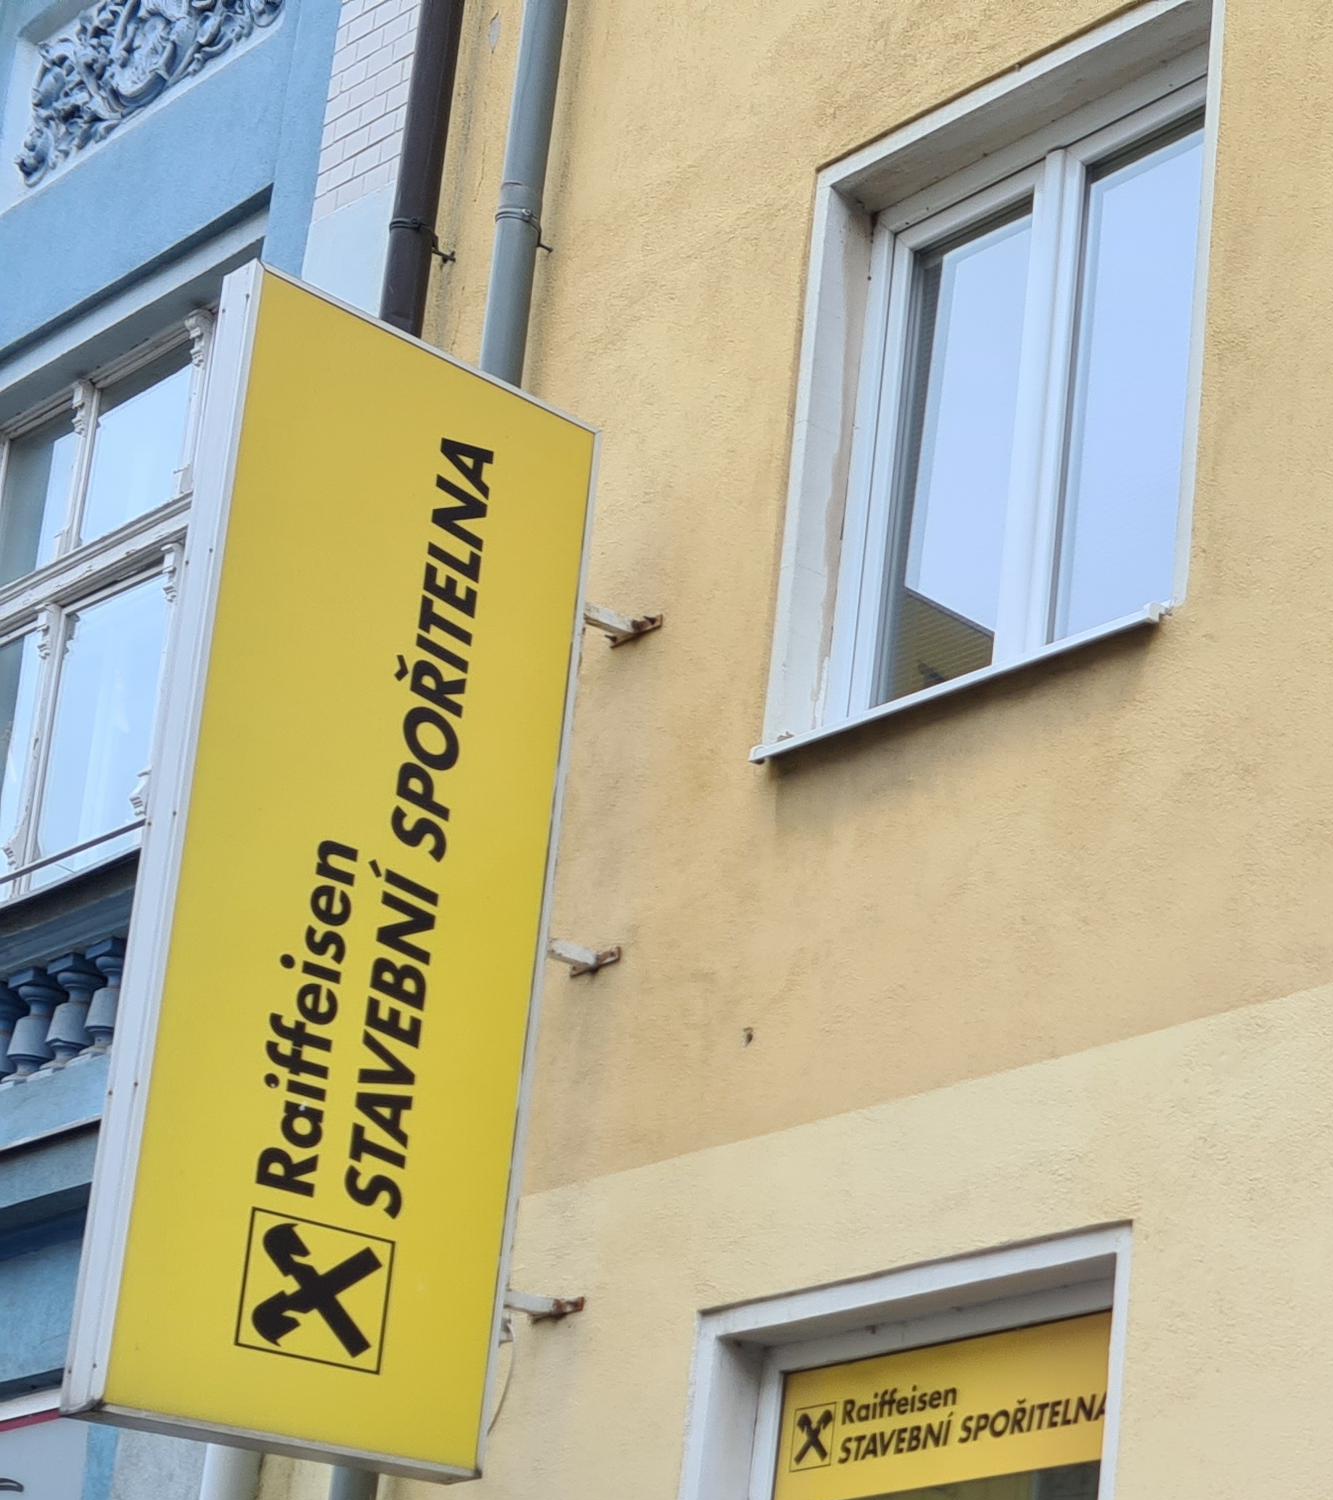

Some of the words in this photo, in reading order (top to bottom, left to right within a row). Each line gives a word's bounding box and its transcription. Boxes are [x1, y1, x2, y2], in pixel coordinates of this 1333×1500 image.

[391, 438, 496, 862] SPOŘITELNA
[256, 838, 358, 1199] Raiffeisen
[345, 860, 441, 1219] STAVEBNÍ
[837, 1413, 954, 1465] STAVEBNÍ
[841, 1386, 958, 1426] Raiffeisen
